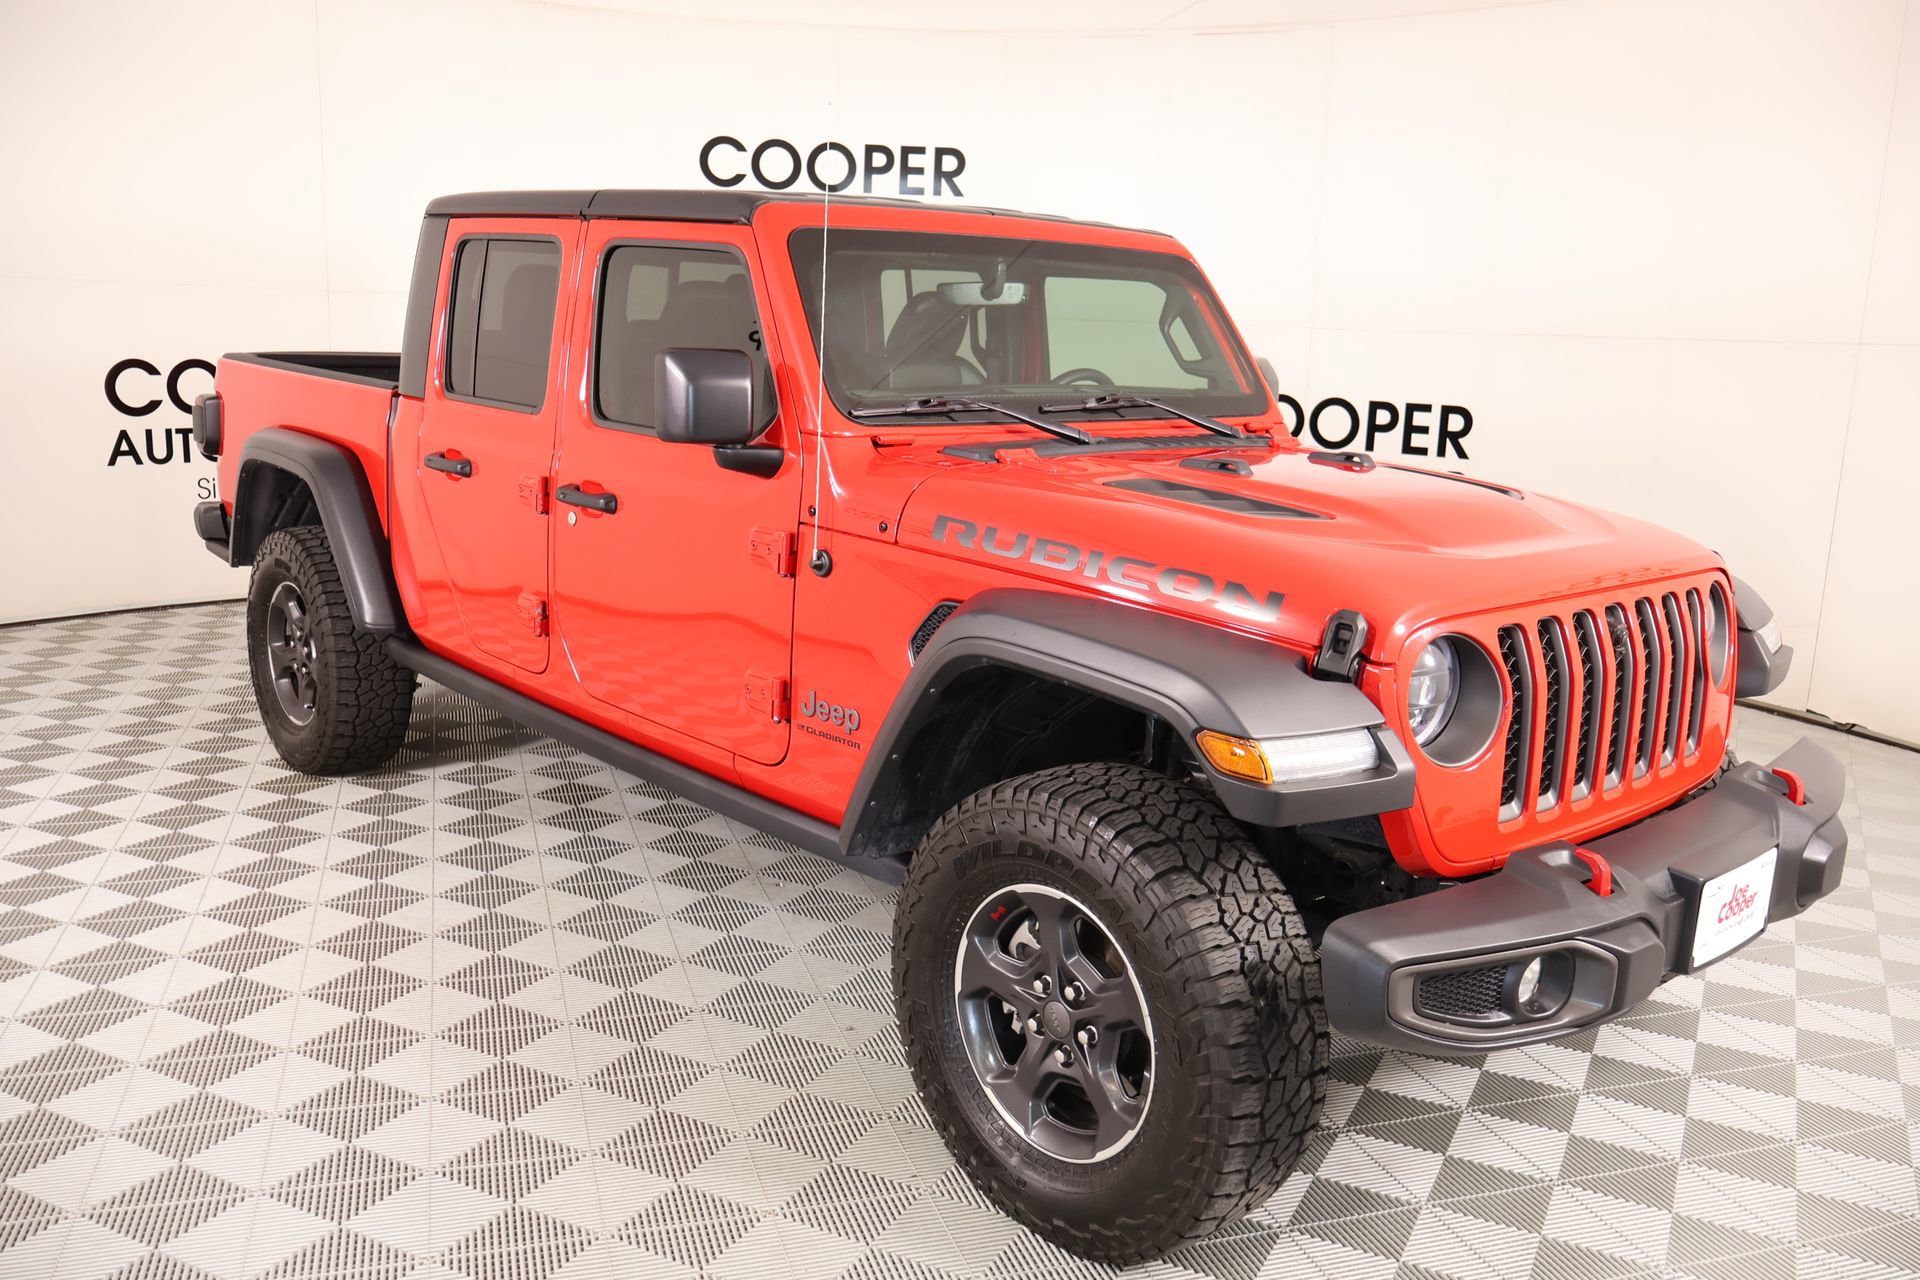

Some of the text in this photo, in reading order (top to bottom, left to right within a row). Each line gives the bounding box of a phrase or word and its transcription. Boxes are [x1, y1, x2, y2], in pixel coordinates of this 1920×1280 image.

[699, 135, 966, 197] COOPER
[104, 358, 216, 417] CO
[107, 427, 218, 466] AUT
[932, 514, 1285, 622] RUBICON
[801, 689, 860, 735] Jeep
[805, 725, 861, 750] GLADIATOR
